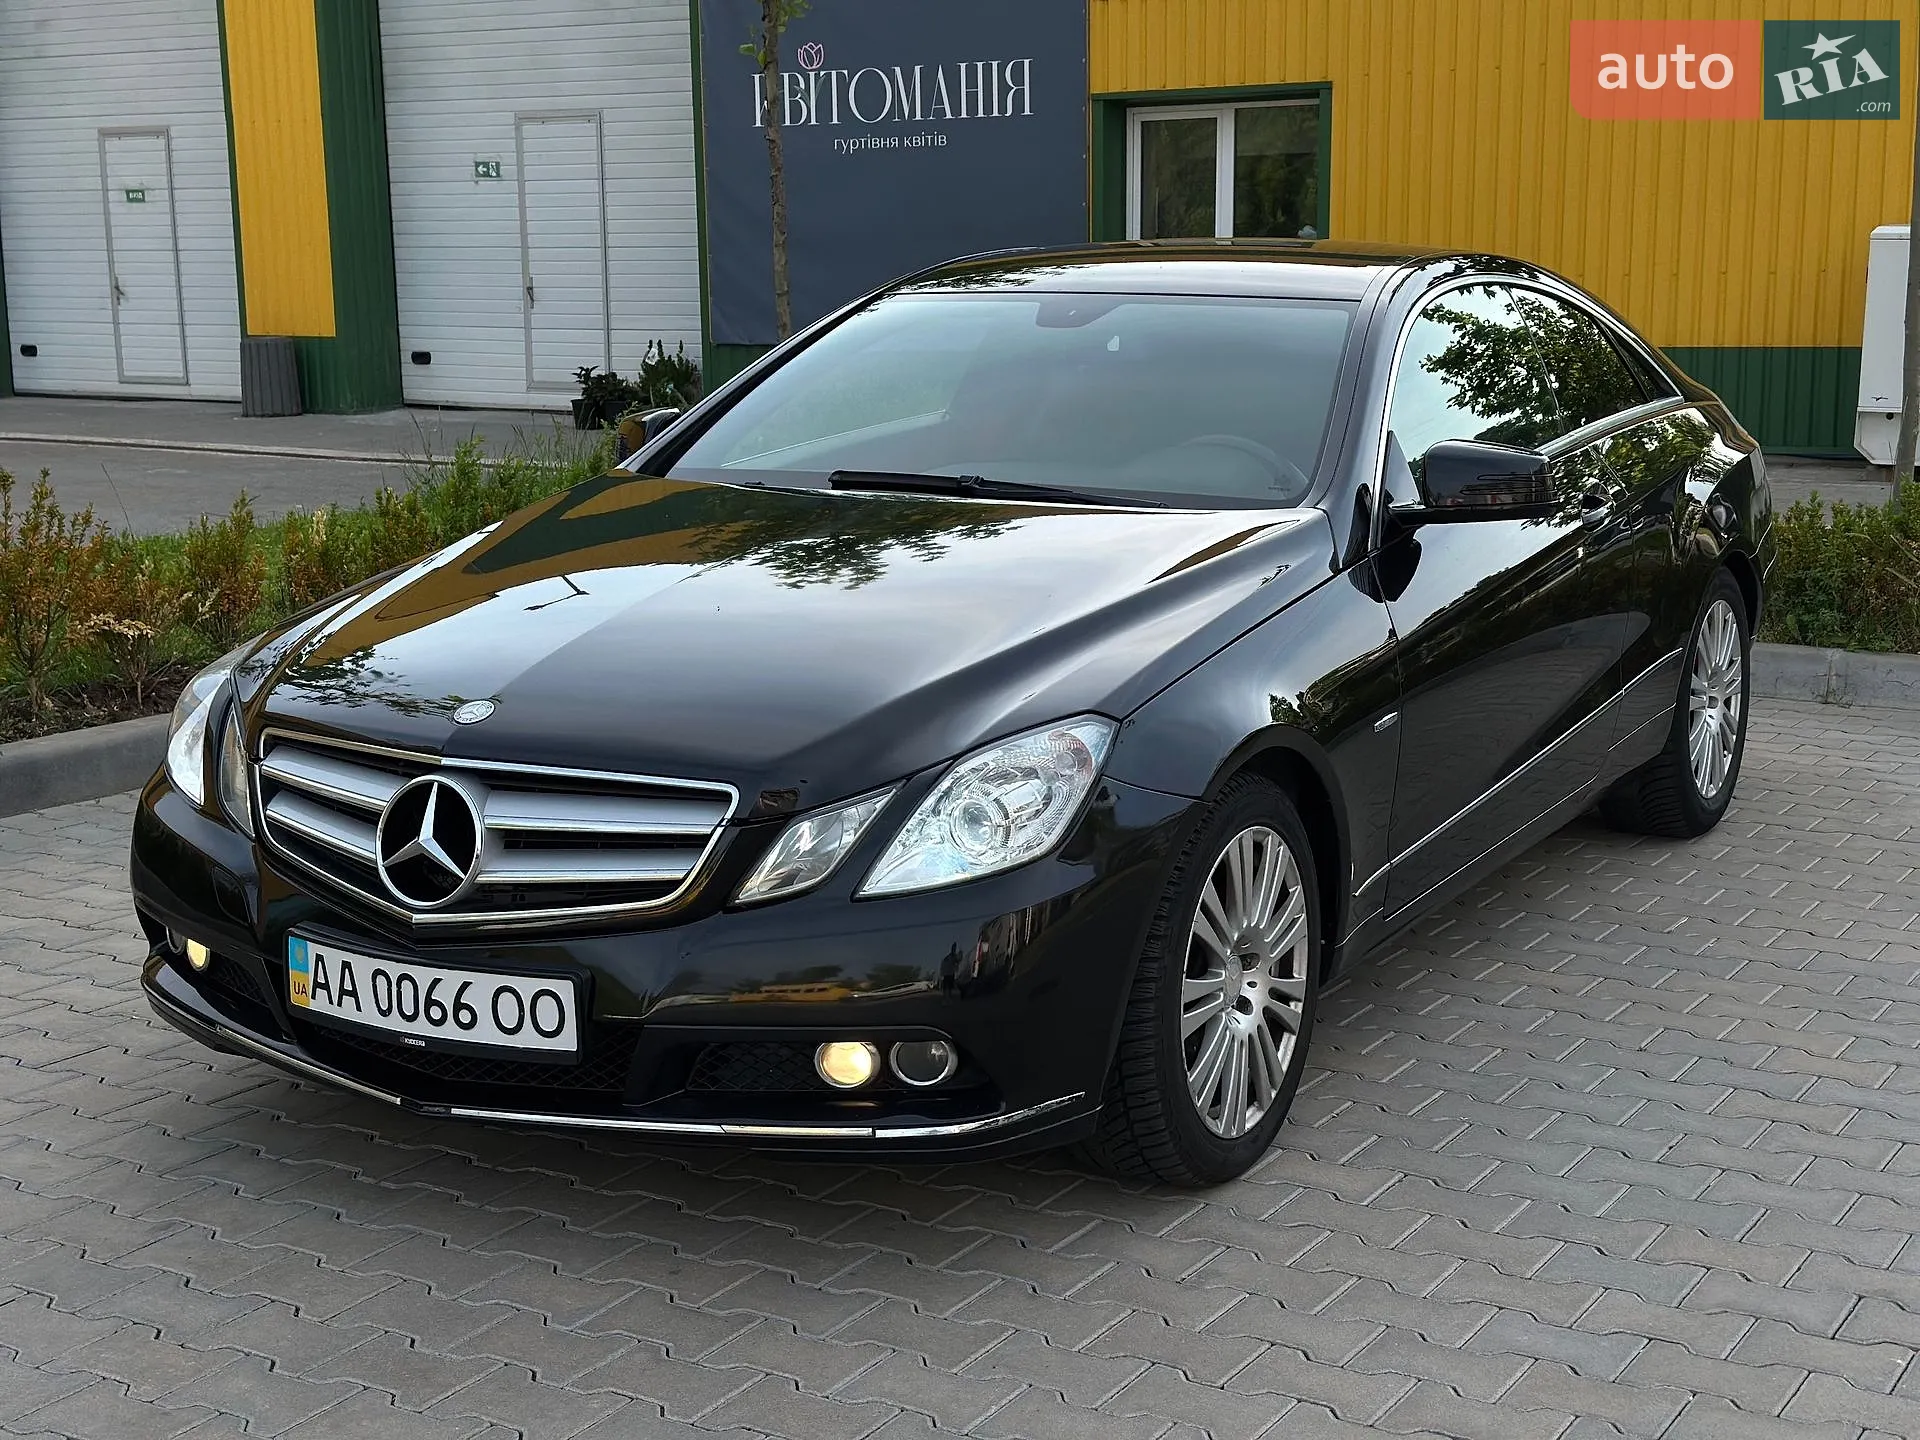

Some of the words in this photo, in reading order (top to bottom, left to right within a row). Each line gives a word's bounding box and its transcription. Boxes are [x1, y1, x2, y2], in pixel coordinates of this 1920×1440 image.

[834, 134, 899, 154] гуртівня
[904, 131, 947, 147] квітів
[293, 980, 308, 998] UA
[311, 952, 363, 1012] AA
[371, 967, 478, 1030] 0066
